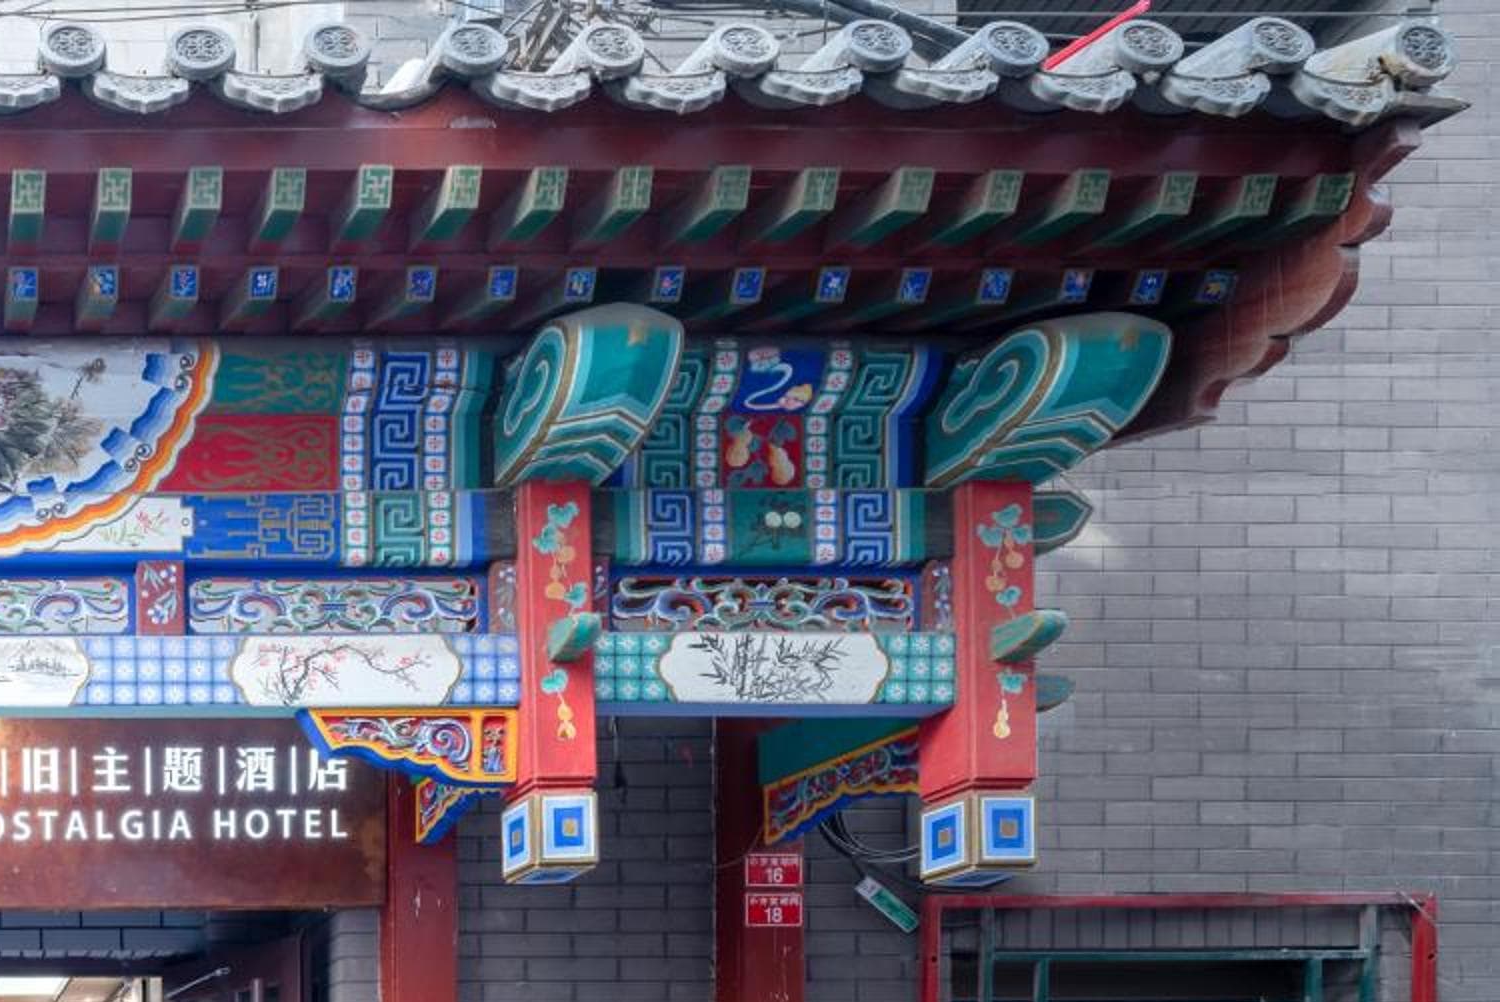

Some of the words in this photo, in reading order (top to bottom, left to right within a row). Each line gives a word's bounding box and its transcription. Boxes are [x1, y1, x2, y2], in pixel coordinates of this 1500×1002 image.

[212, 808, 349, 840] HOTEL
[764, 867, 784, 883] 16
[763, 906, 783, 923] 18
